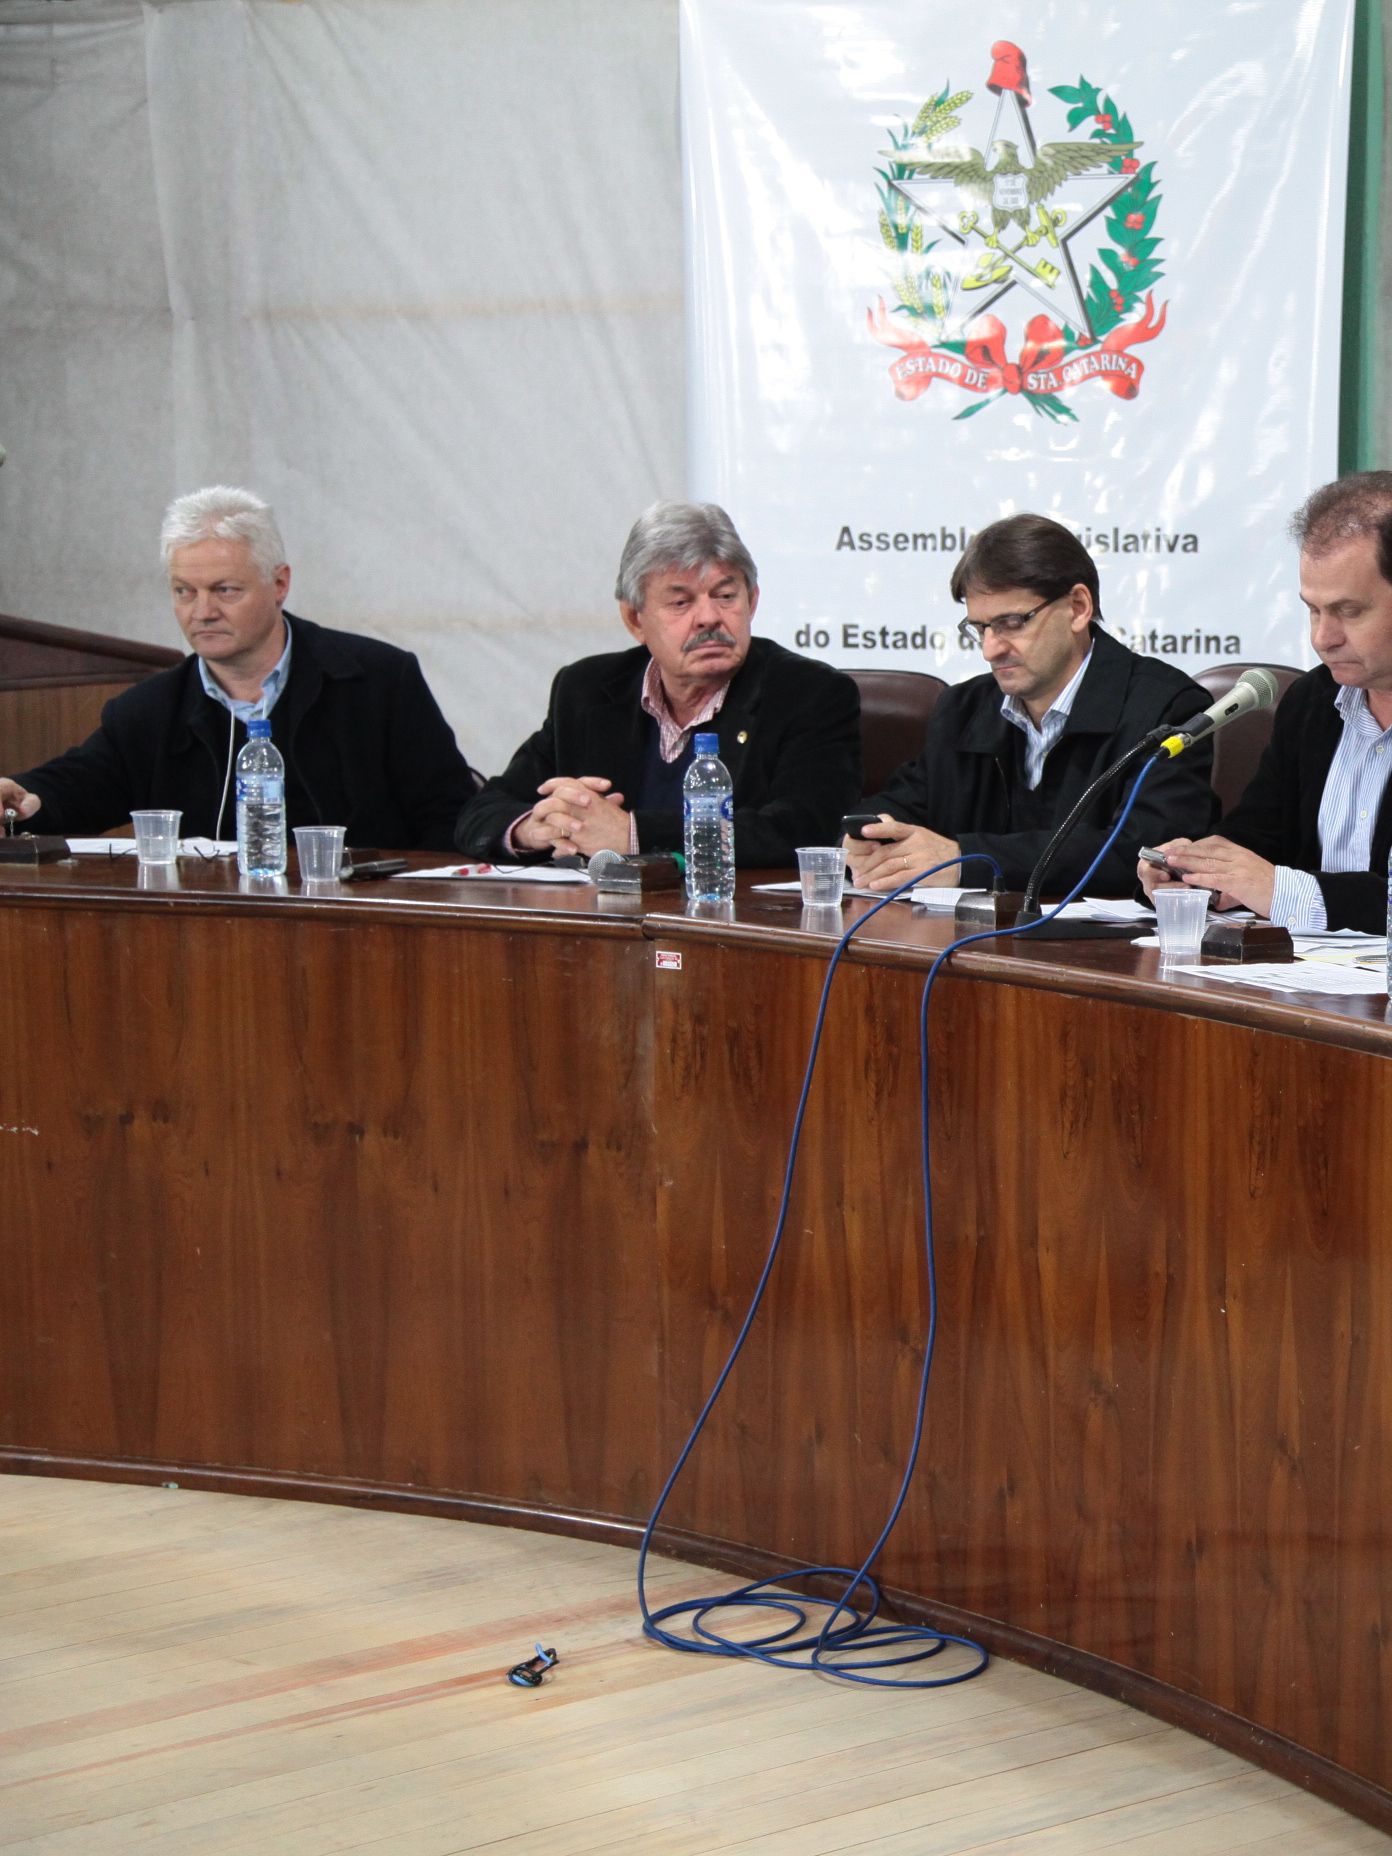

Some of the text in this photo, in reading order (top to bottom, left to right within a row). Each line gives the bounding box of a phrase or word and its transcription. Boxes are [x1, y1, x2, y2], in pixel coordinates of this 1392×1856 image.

[896, 353, 1138, 391] ESTADO DE STA. CATARINA
[835, 525, 1200, 554] Assembl islativa
[794, 623, 831, 650] do
[842, 623, 946, 650] Estado
